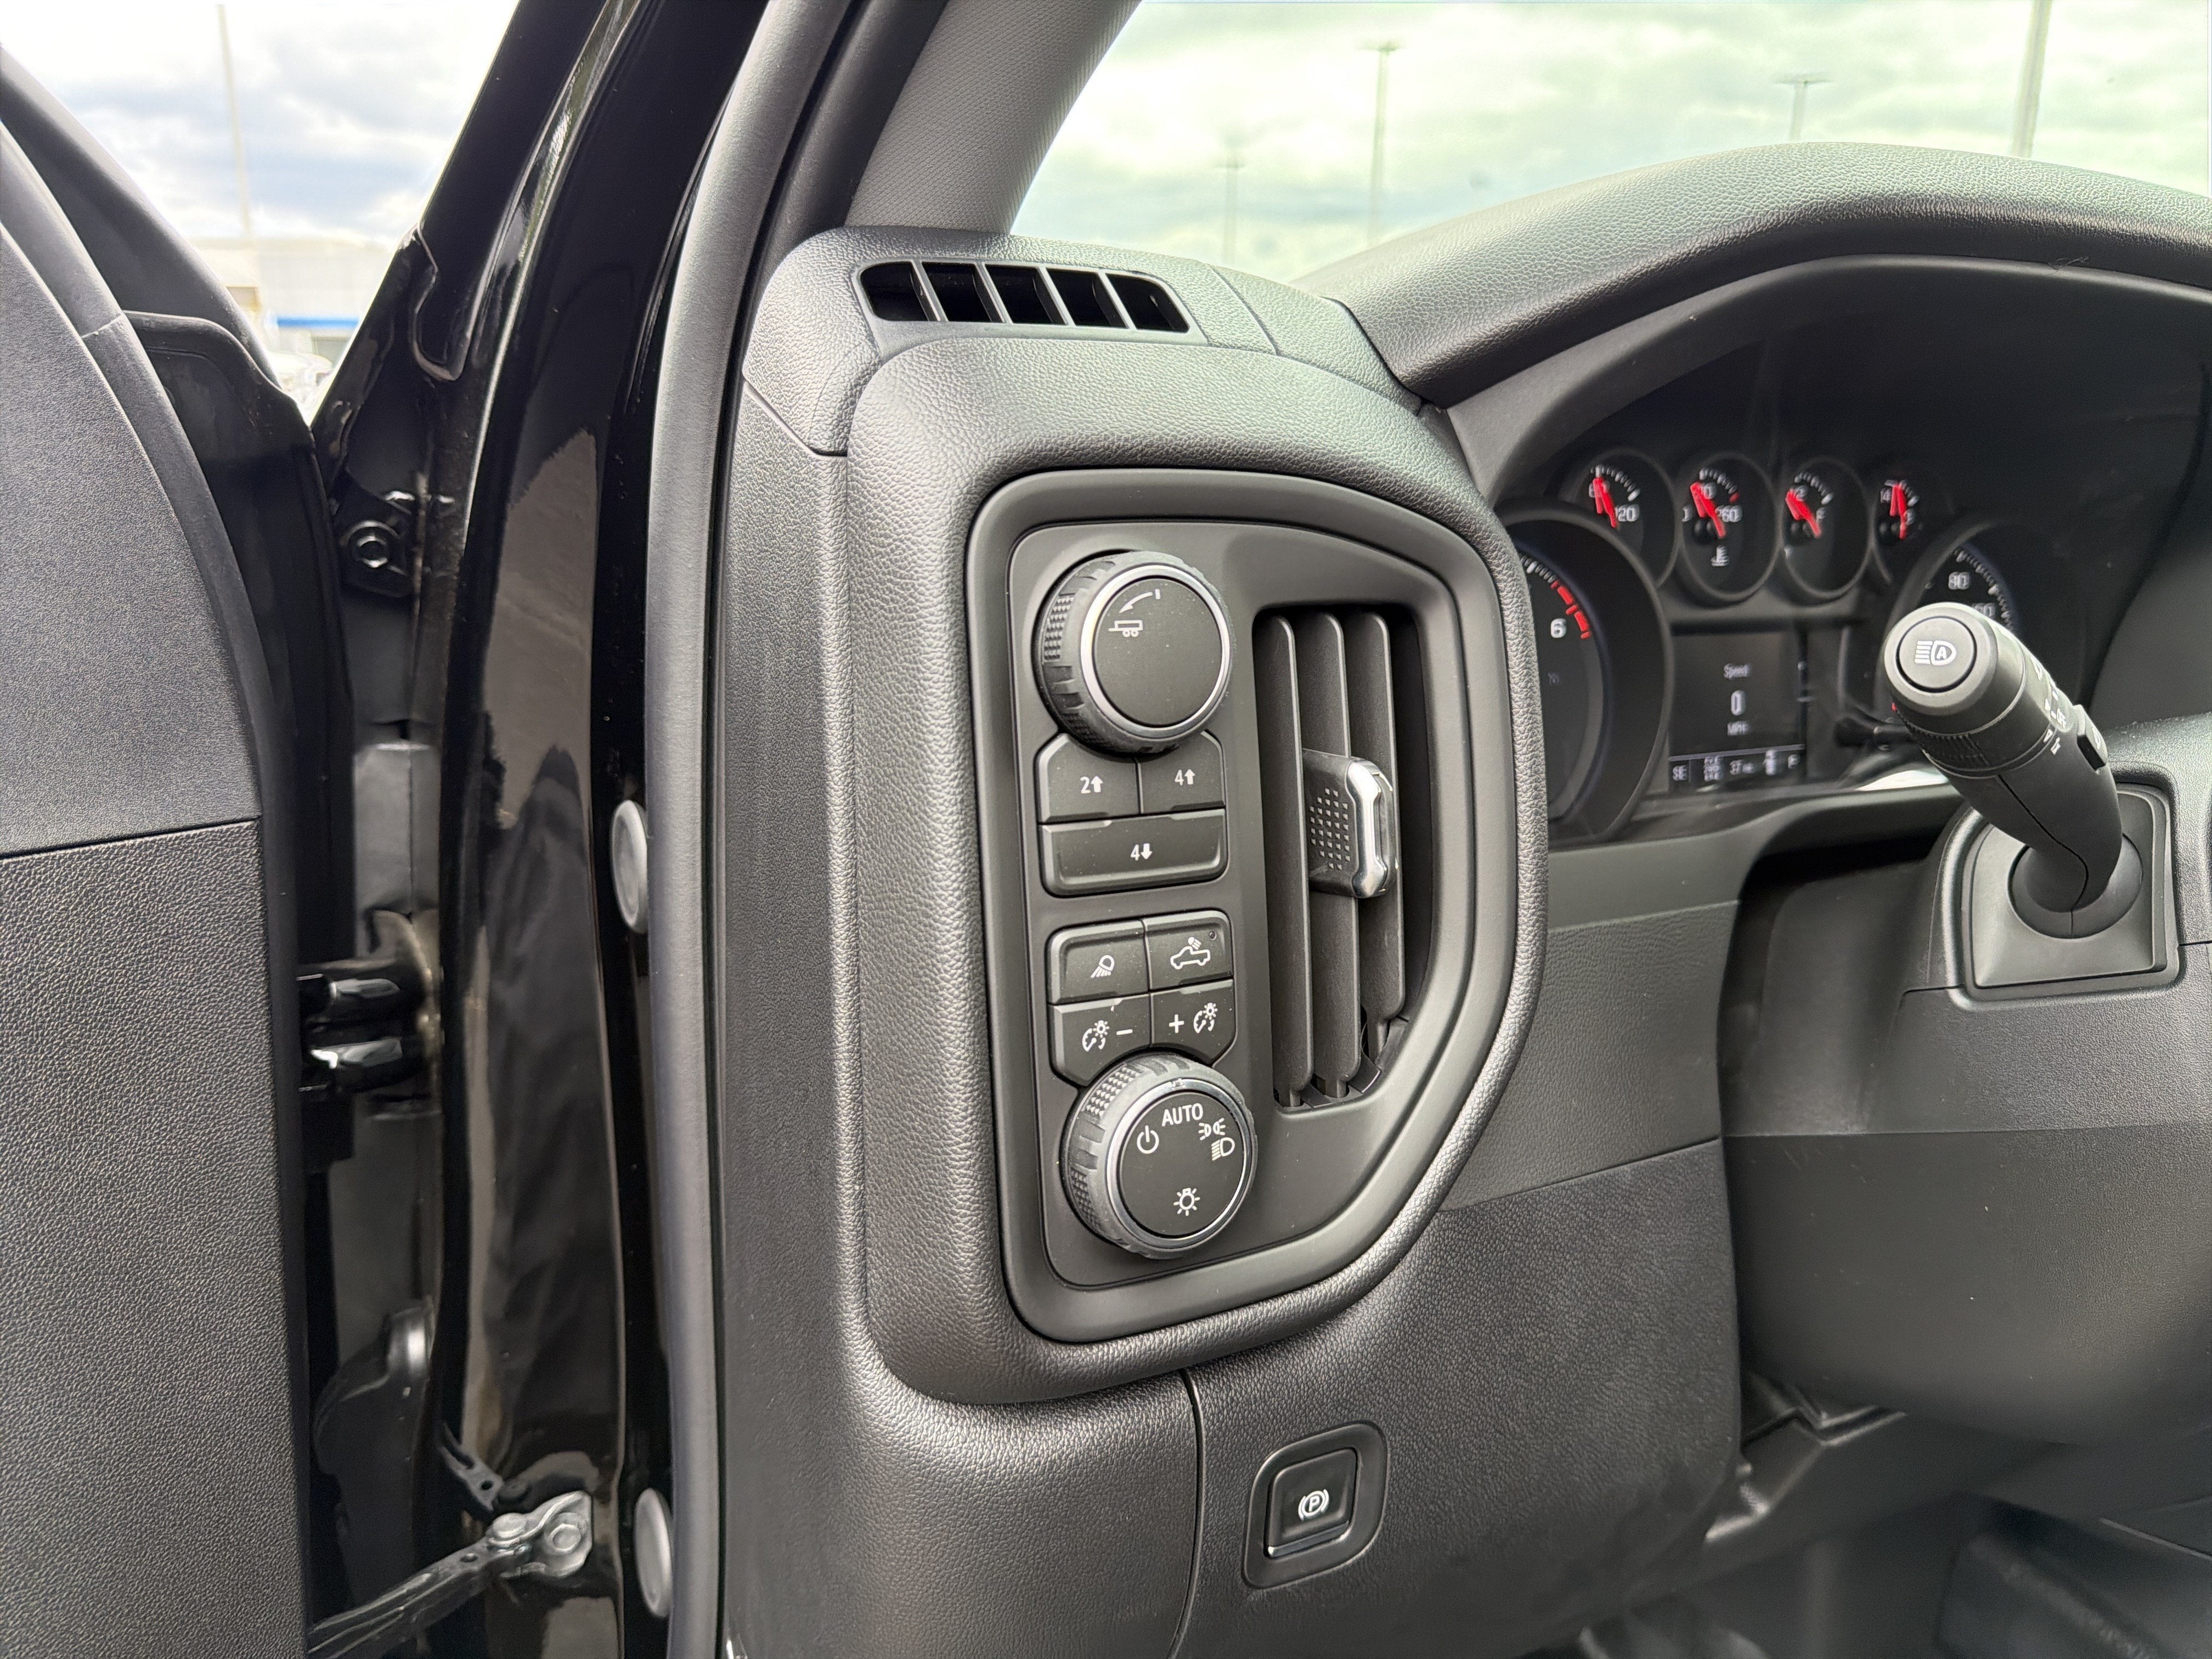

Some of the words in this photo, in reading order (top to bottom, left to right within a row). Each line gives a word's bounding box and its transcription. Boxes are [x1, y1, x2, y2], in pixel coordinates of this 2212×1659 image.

[1551, 618, 1567, 638] 6
[1936, 646, 1947, 659] A
[1080, 776, 1091, 794] 2
[1174, 769, 1184, 786] 4
[1130, 844, 1141, 861] 4
[1161, 1103, 1204, 1127] AUTO
